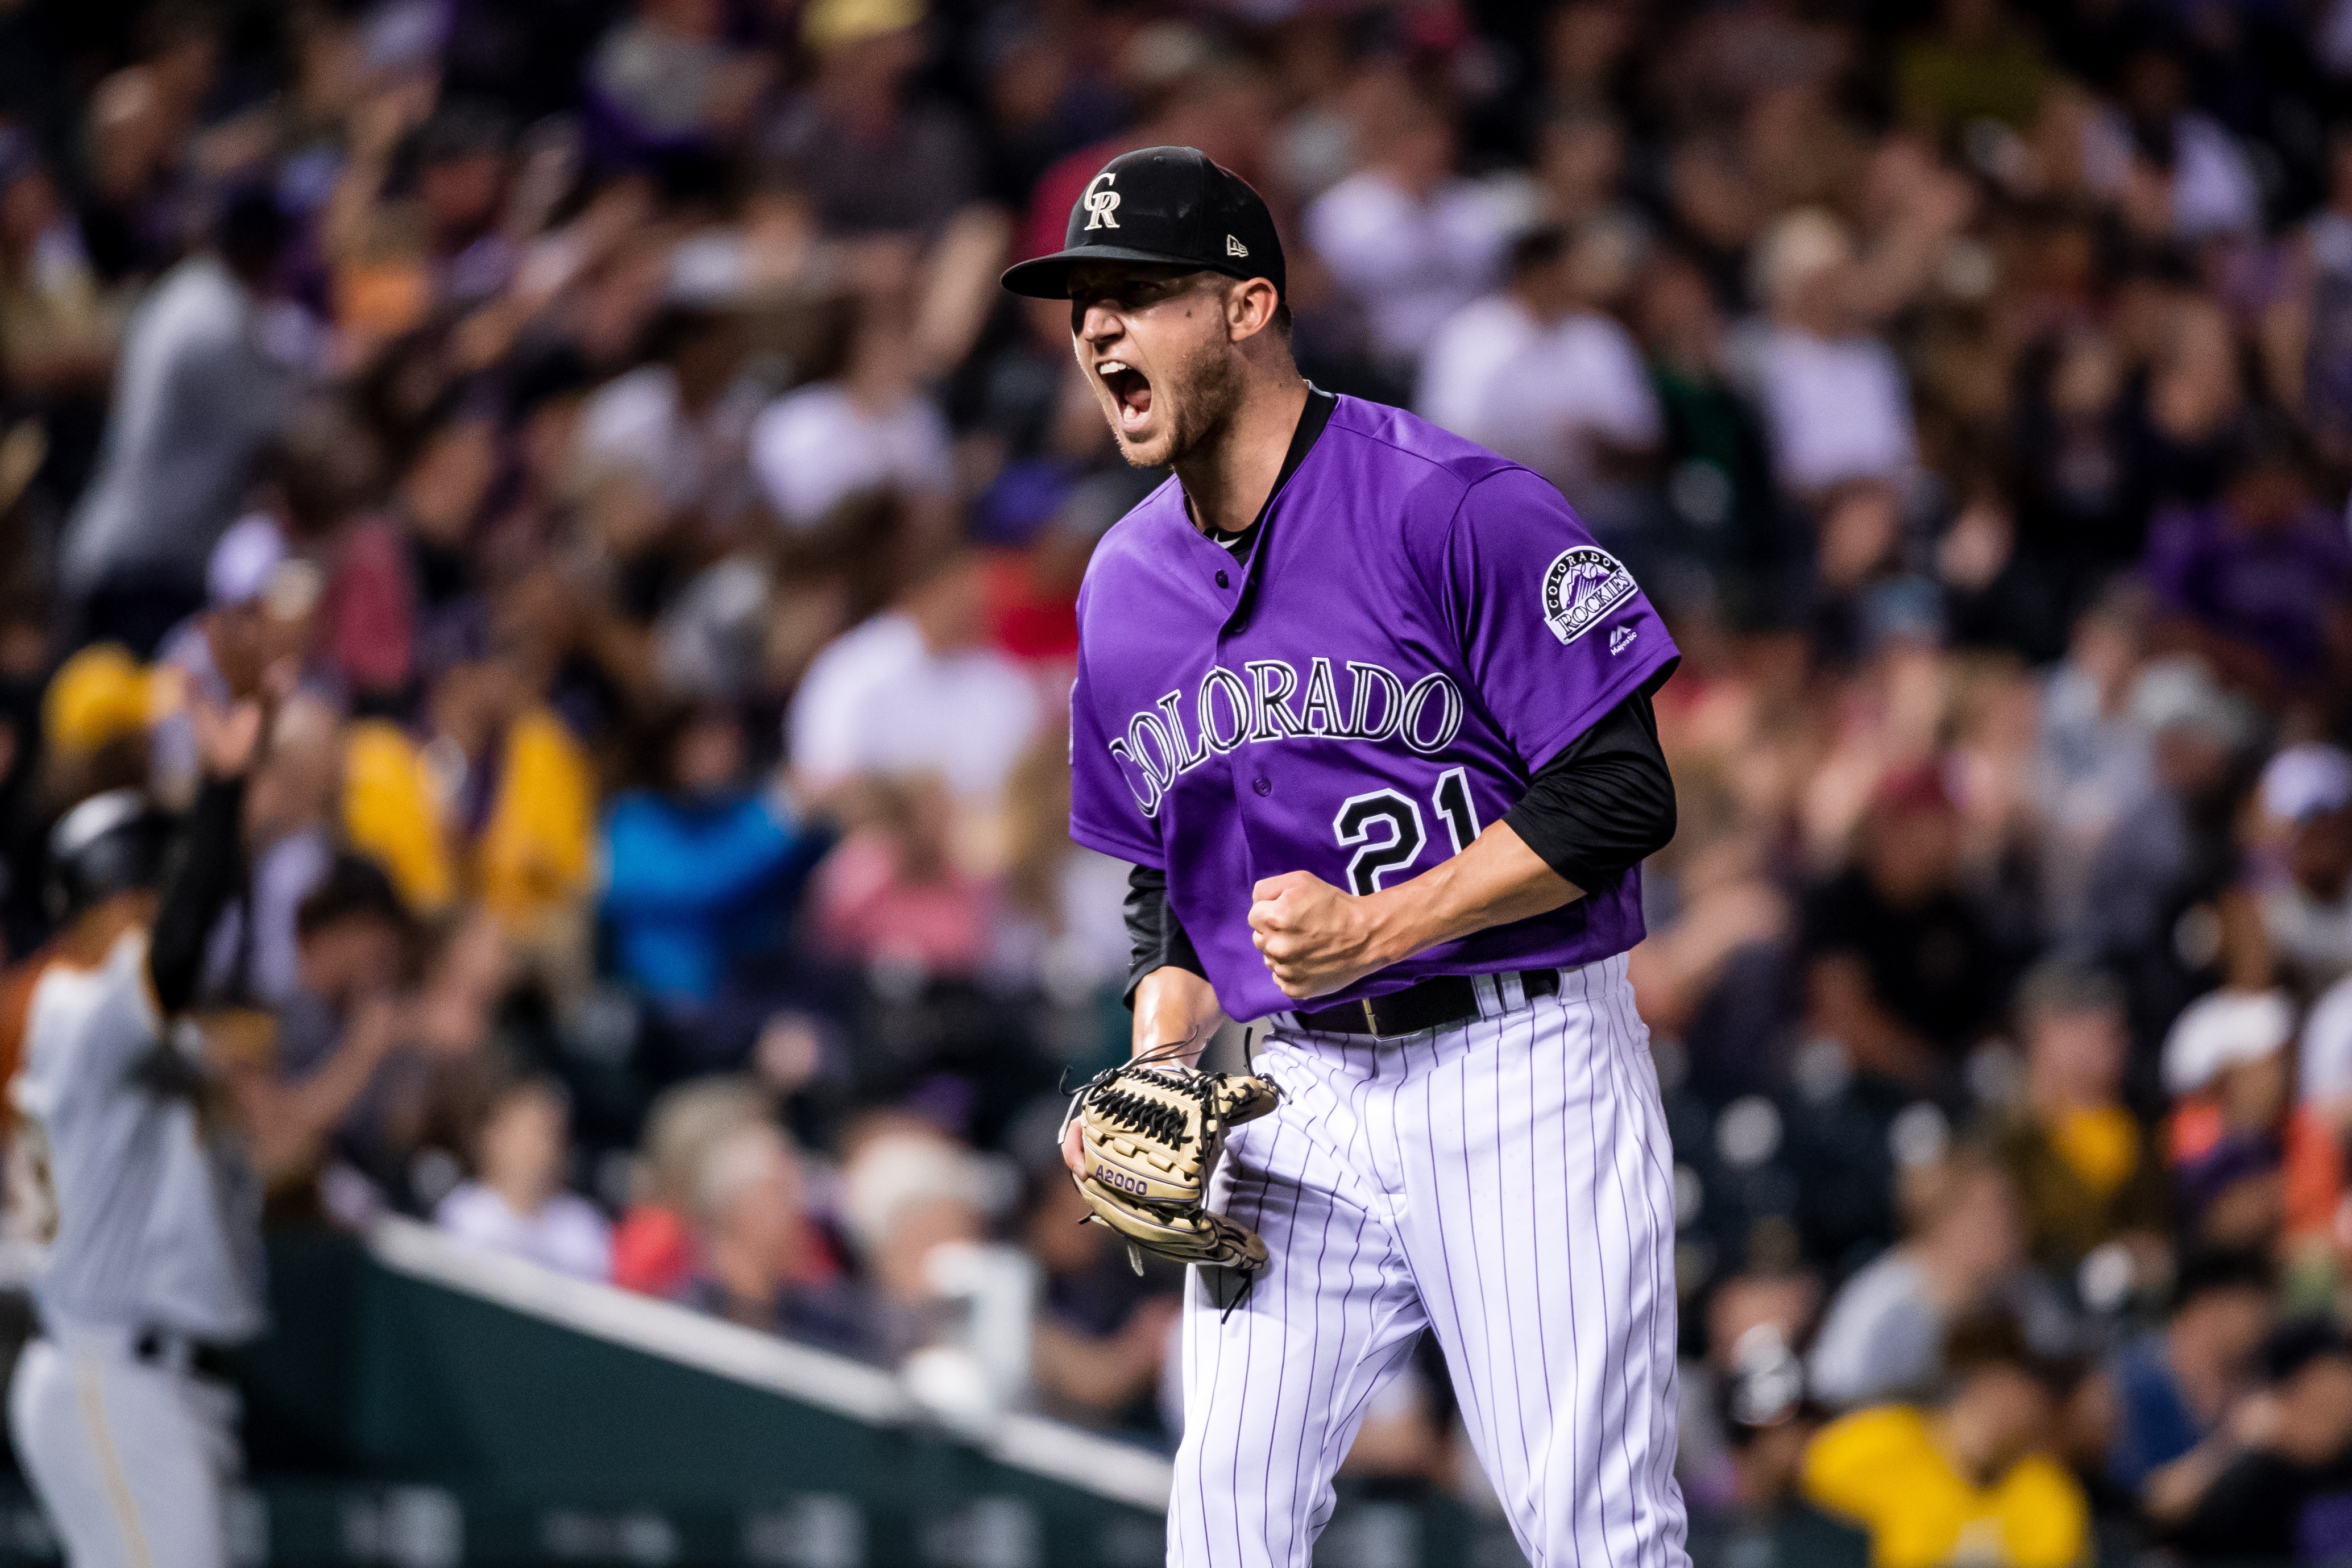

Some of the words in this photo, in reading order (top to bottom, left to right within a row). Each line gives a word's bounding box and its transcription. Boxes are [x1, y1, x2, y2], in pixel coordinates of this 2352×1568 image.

[1084, 172, 1121, 230] CR
[1548, 551, 1611, 608] COLORADO
[1555, 569, 1631, 636] ROCKIES
[1610, 632, 1637, 656] Majestic
[1109, 657, 1463, 818] COLORADO
[1333, 766, 1480, 897] 21
[1095, 1164, 1148, 1196] A2000
